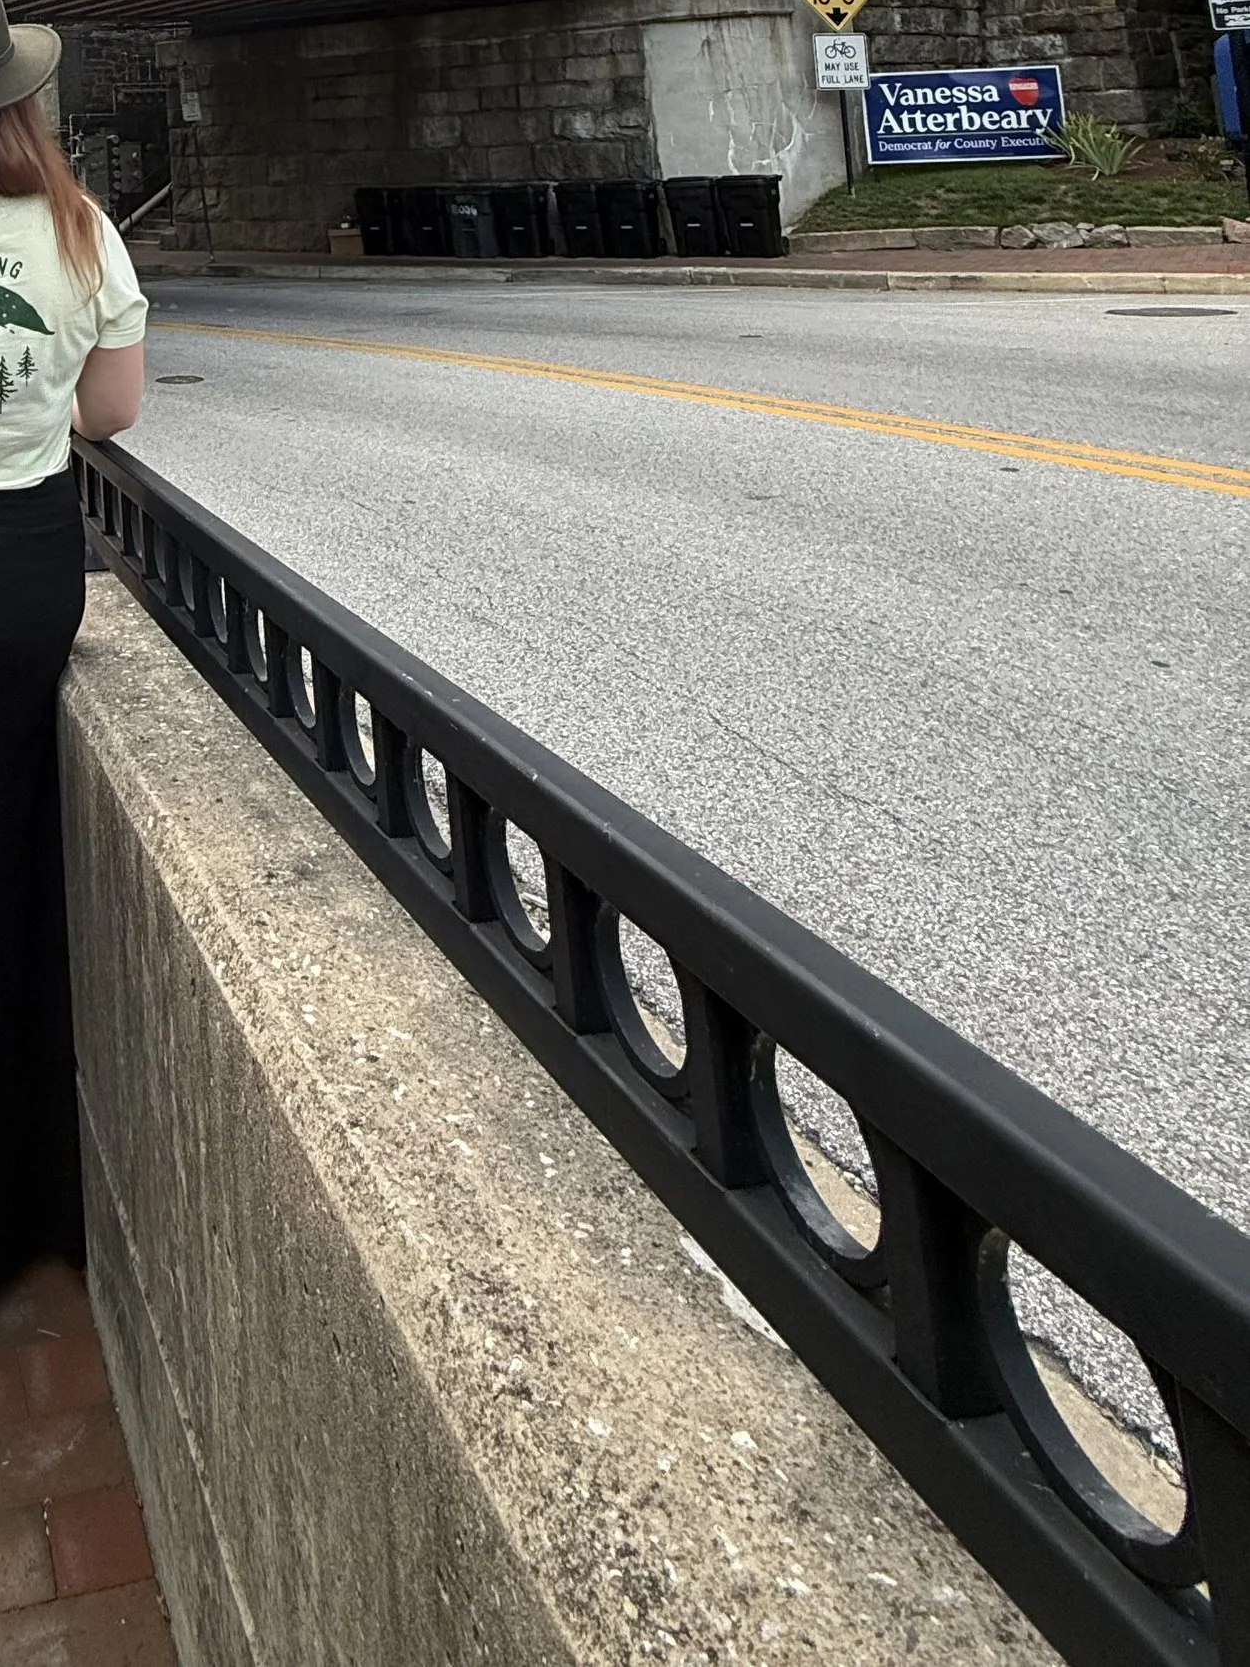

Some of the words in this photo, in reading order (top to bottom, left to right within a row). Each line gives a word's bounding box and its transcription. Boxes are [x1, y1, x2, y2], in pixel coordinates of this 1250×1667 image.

[824, 62, 841, 71] MAY
[844, 61, 859, 71] USE
[822, 75, 841, 84] FULL
[844, 74, 865, 84] LANE
[878, 83, 1000, 107] Vanessa
[877, 105, 1053, 134] Atterbeary
[878, 140, 933, 152] Democrat
[934, 138, 952, 151] for
[953, 137, 998, 150] County
[1000, 135, 1055, 148] Executi
